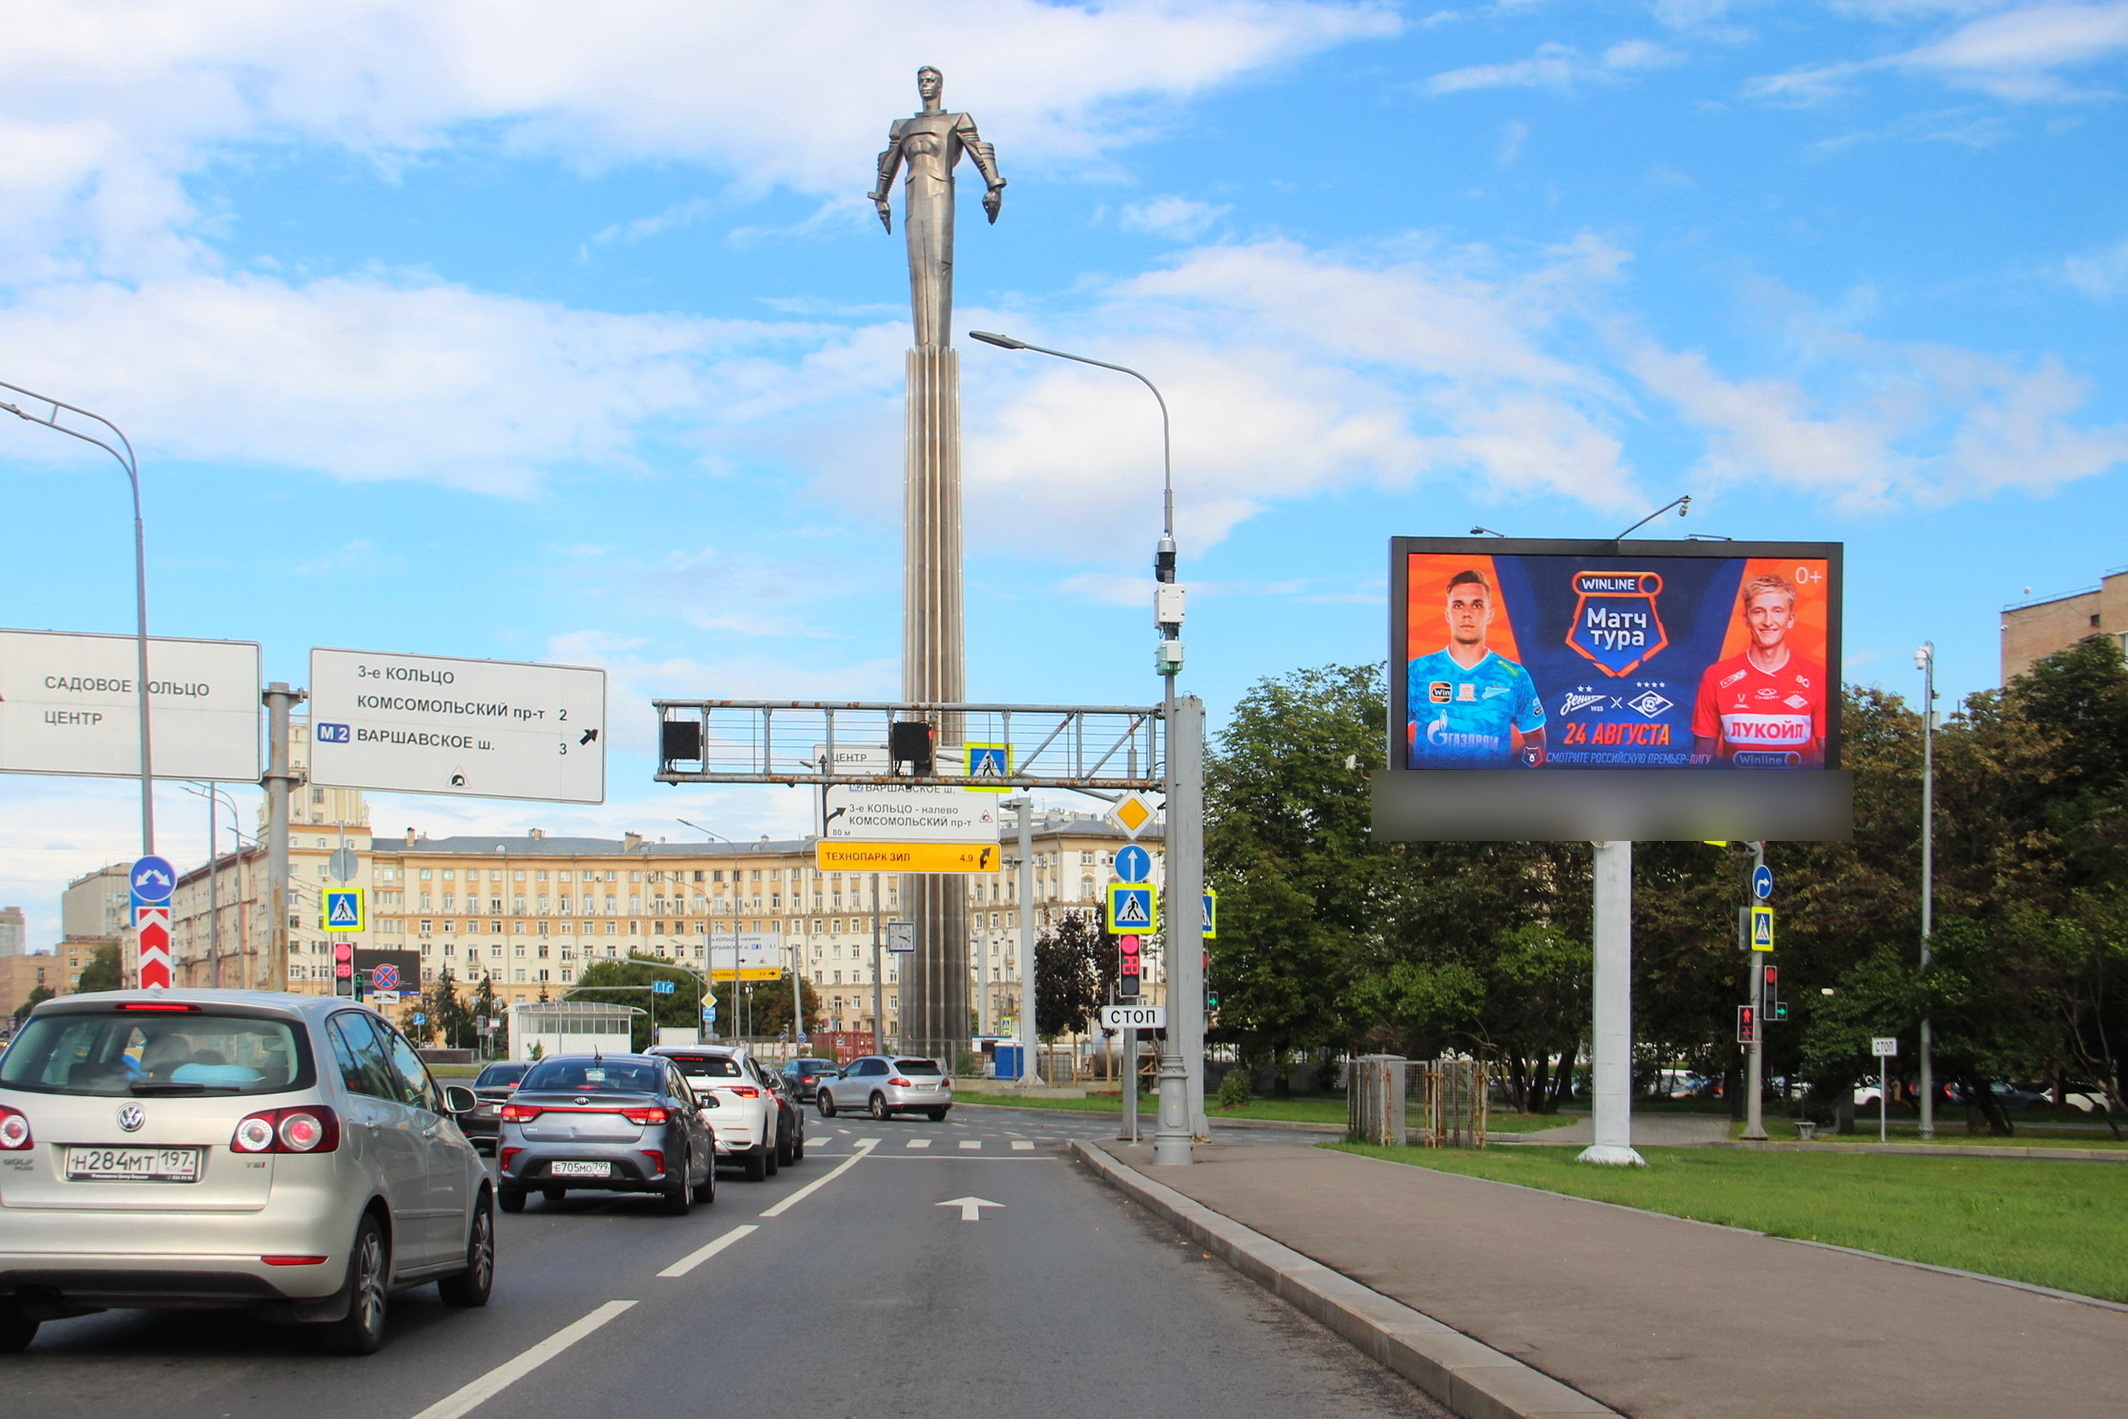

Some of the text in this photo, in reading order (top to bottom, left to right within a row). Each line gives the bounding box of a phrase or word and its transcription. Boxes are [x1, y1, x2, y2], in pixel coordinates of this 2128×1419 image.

[1795, 566, 1822, 584] 0+
[1581, 578, 1635, 590] WINLINE
[1587, 607, 1647, 628] Матч
[1590, 630, 1645, 650] тура
[358, 665, 455, 686] 3-е КОЛЬЦО
[44, 675, 210, 698] САДОВОЕ ОЛЬЦО
[357, 695, 568, 722] КОМСОМОЛЬСКИЙ пр-т 2
[44, 710, 103, 726] ЦЕНТР
[1563, 722, 1671, 746] 24 АВГУСТА
[1730, 720, 1805, 739] ЛУКОЙЛ
[356, 728, 473, 749] ВАРШАВСКОЕ
[478, 739, 495, 750] ш.
[558, 743, 568, 756] 3
[1448, 733, 1499, 750] ГАЗПРОМ
[1546, 751, 1712, 764] СМОТРИТЕ РОССИЙСКУЮ ПРЕМЬЕР-ЛИГУ
[1739, 755, 1782, 764] Winline
[849, 804, 864, 813] 3-е
[868, 804, 913, 815] КОЛЬЦО
[922, 806, 958, 815] налево
[849, 816, 972, 829] КОМСОМОЛЬСКИЙ пр-т
[826, 852, 974, 862] ТЕХНОПАРК ЗИЛ 4.9
[1122, 955, 1139, 975] 28
[1110, 1010, 1156, 1024] СТОП
[1875, 1040, 1894, 1053] СТОП
[161, 1151, 190, 1166] 197
[594, 1162, 608, 1170] 799
